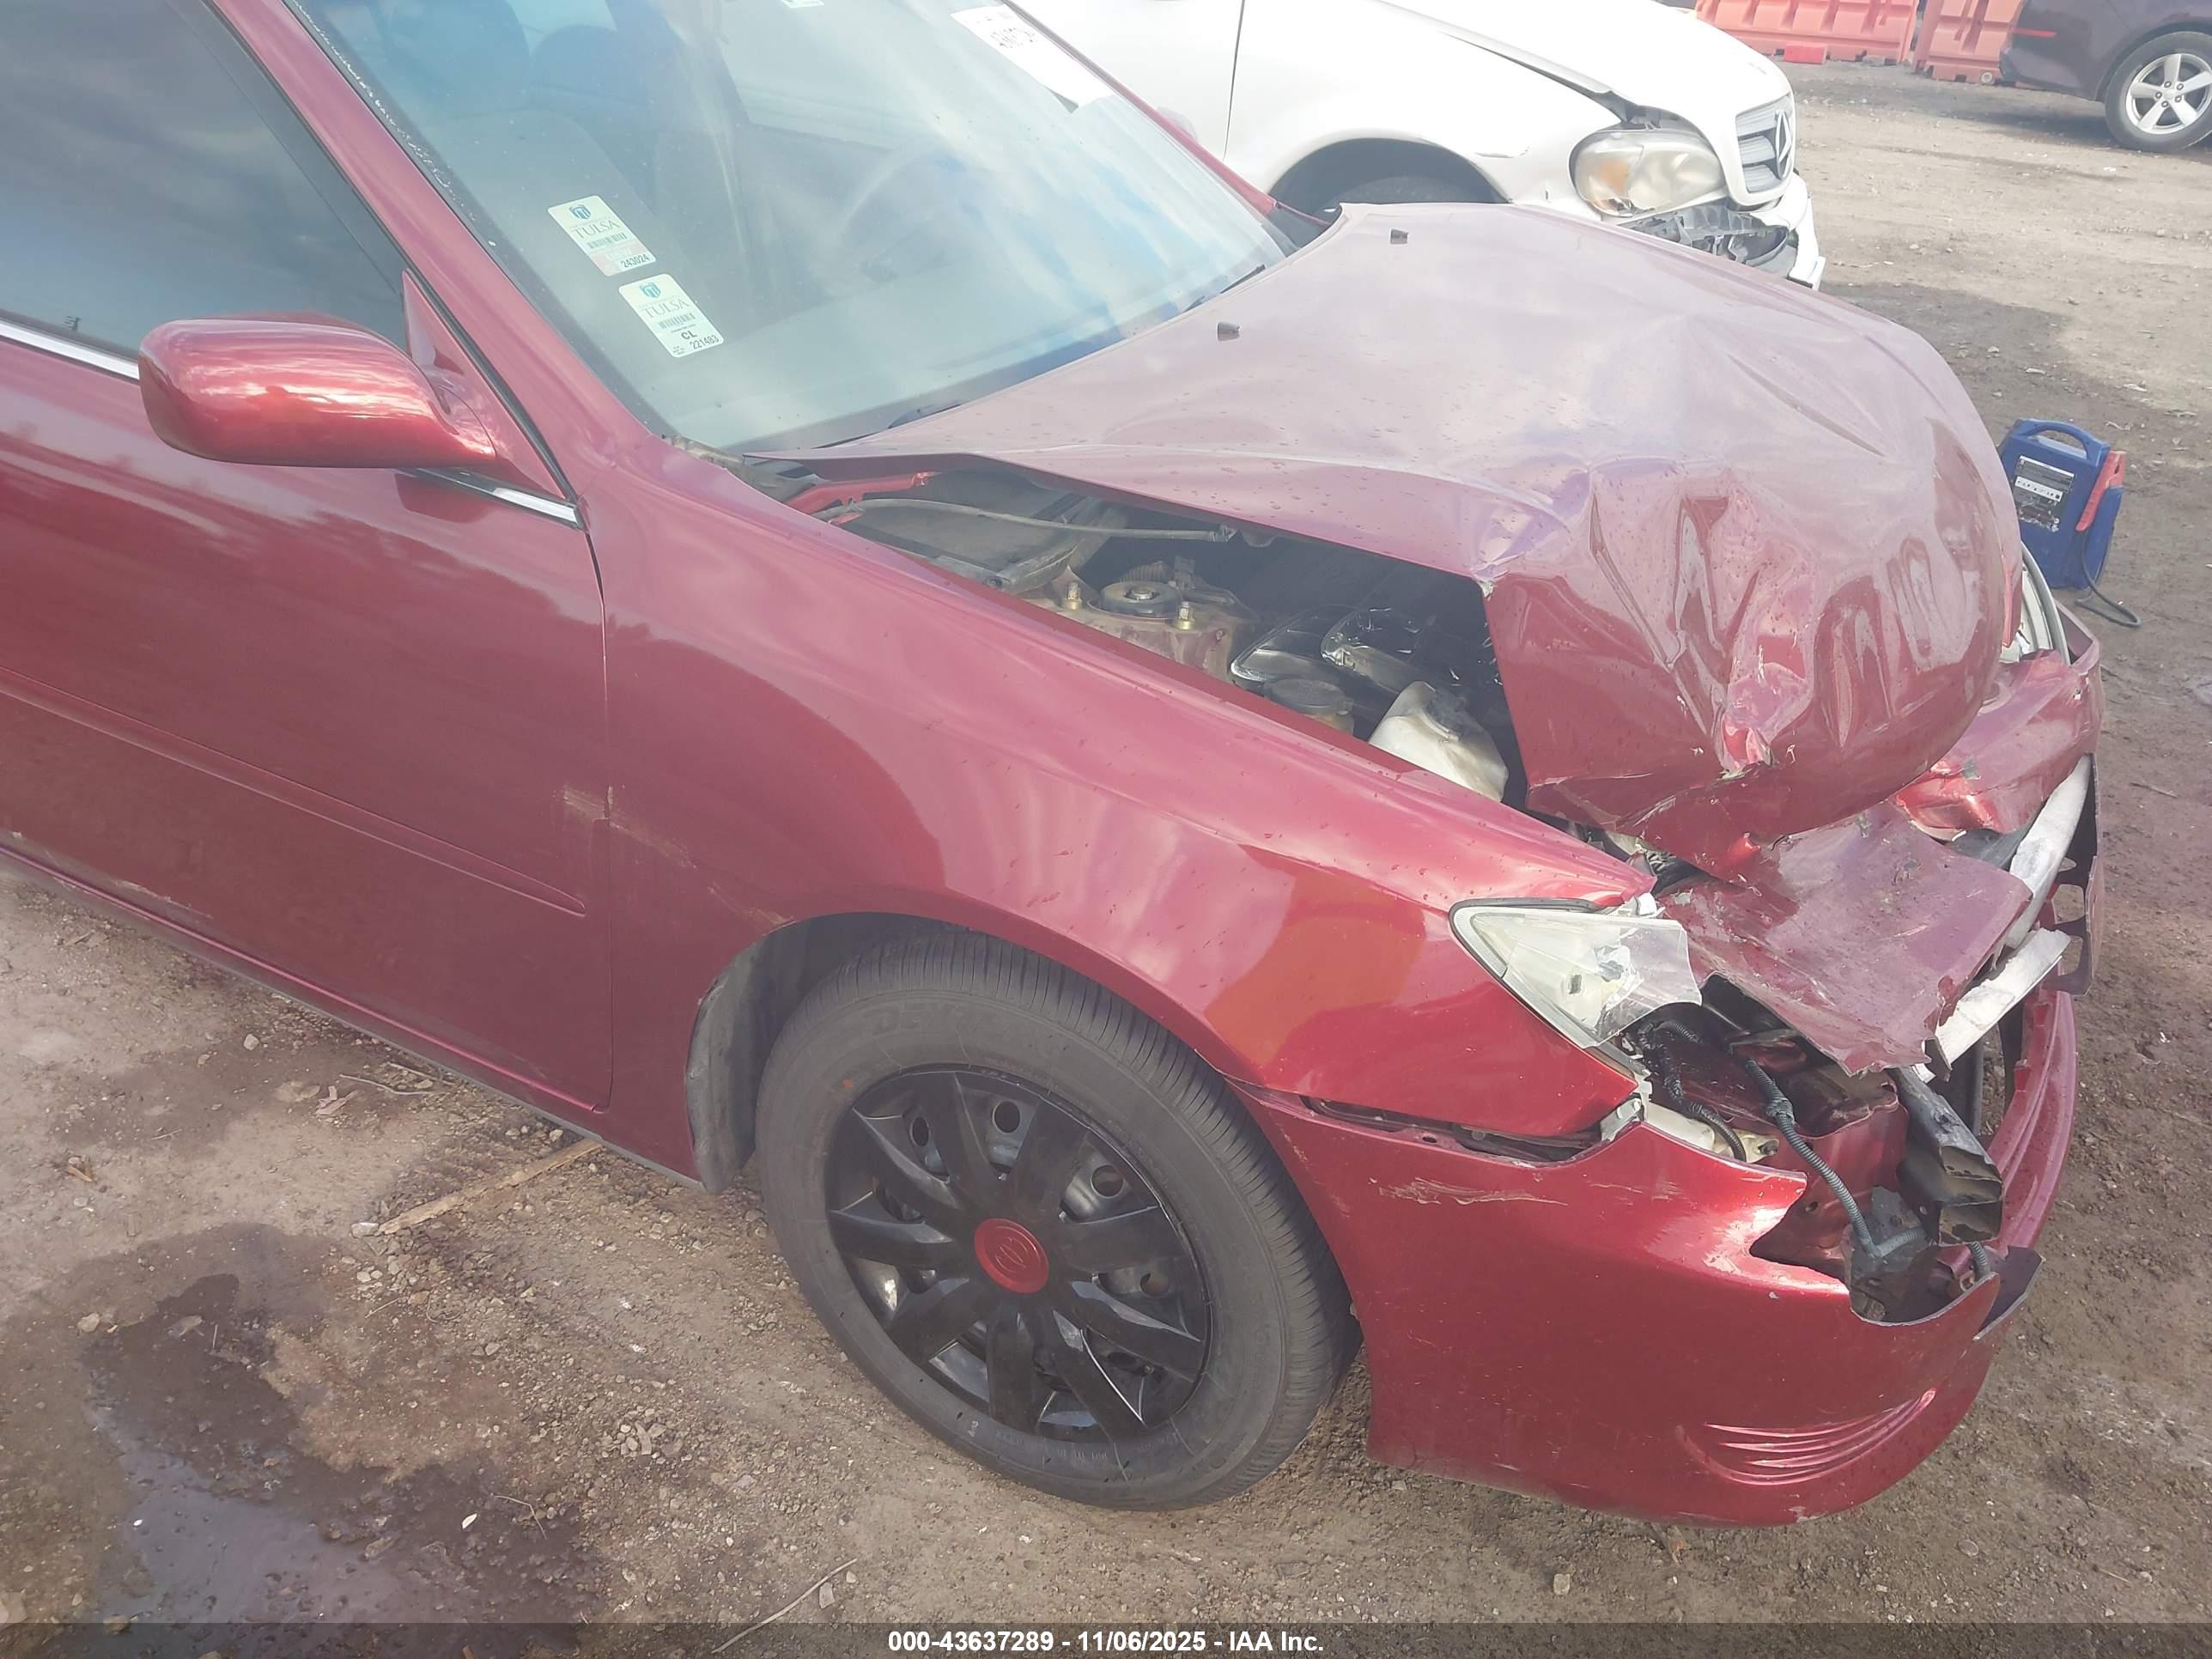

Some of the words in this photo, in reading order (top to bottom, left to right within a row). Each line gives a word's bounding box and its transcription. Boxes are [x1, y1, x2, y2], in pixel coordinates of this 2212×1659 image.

[572, 219, 621, 240] TULSA
[621, 253, 650, 268] 243024
[644, 297, 690, 318] TULSA
[680, 329, 698, 340] CL
[690, 334, 720, 349] 221483
